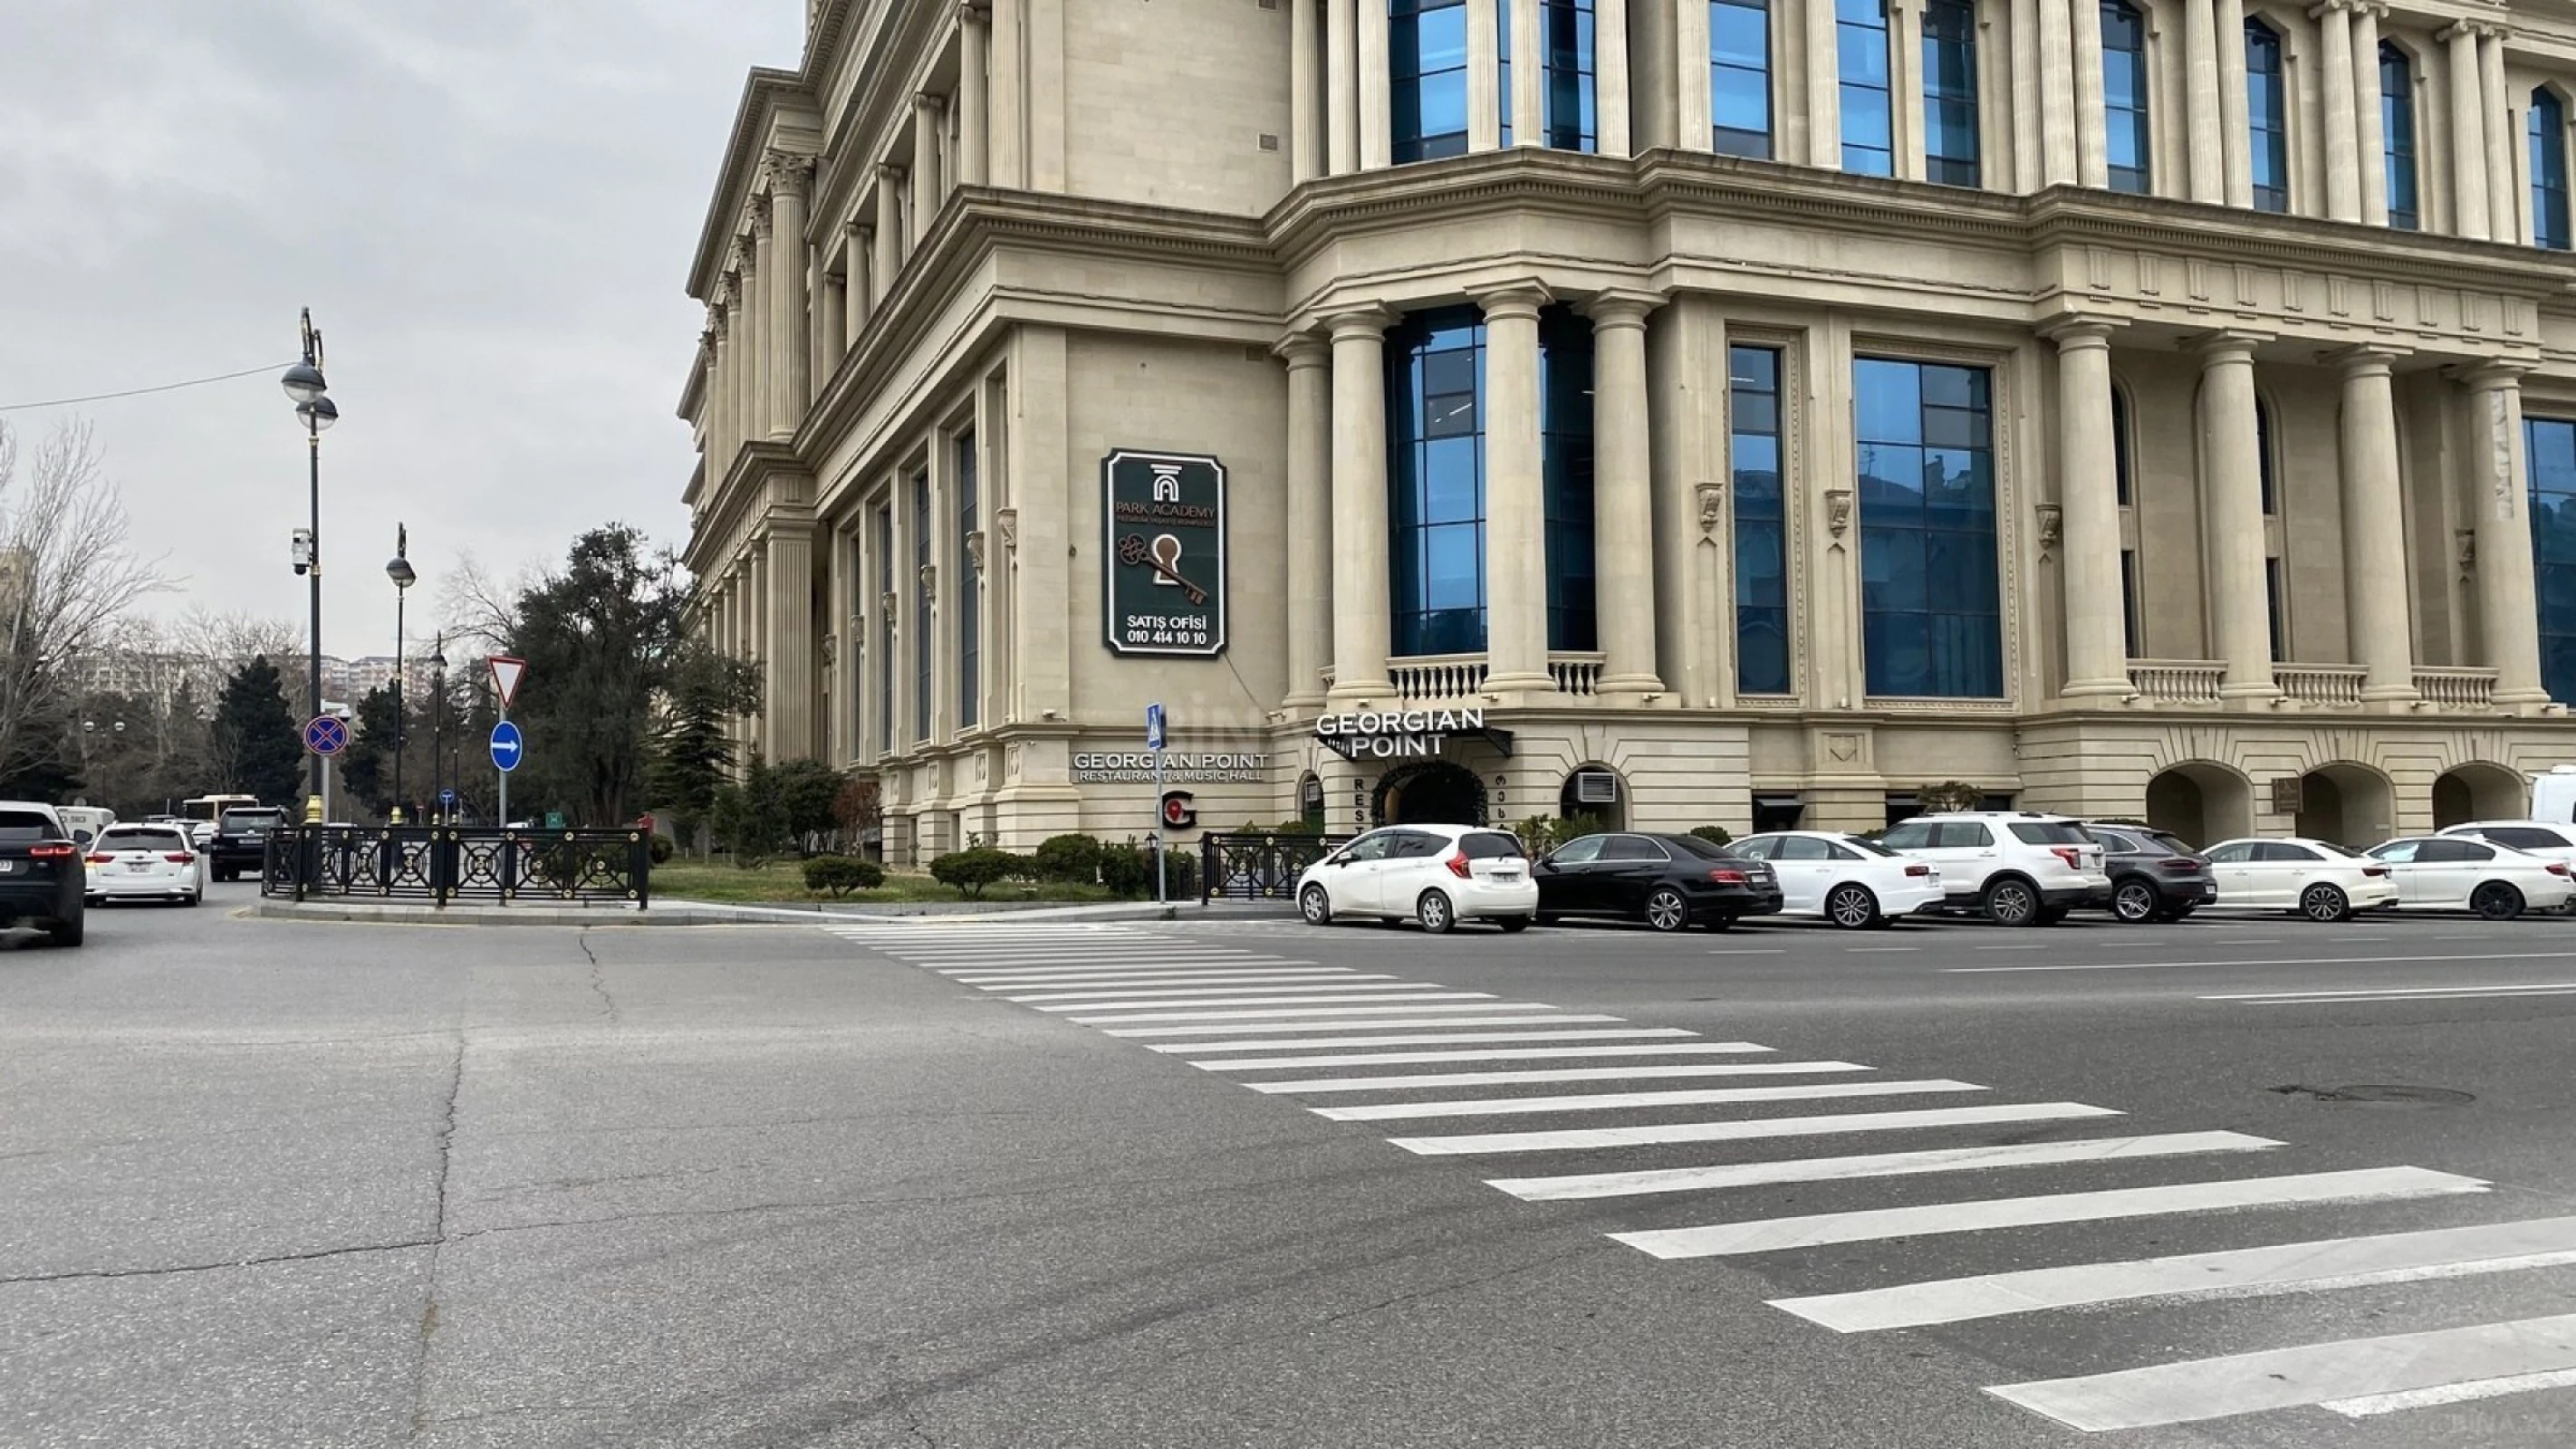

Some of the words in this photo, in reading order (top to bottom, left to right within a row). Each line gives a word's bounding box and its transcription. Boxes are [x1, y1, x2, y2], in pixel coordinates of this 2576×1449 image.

[1115, 502, 1149, 514] PARK
[1153, 504, 1215, 518] ACADEMY
[1127, 615, 1167, 631] SATIŞ
[1169, 615, 1207, 630] OFİSİ
[1127, 629, 1149, 643] 010
[1152, 630, 1173, 644] 414
[1177, 631, 1190, 644] 10
[1193, 631, 1207, 645] 10
[1316, 707, 1485, 734] GEORGIAN
[1351, 734, 1447, 757] POINT
[1074, 753, 1194, 769] GEORGAN
[1202, 754, 1269, 770] POINT
[1172, 771, 1182, 781] &
[1184, 771, 1226, 781] MUSIC
[1229, 771, 1264, 781] HALL
